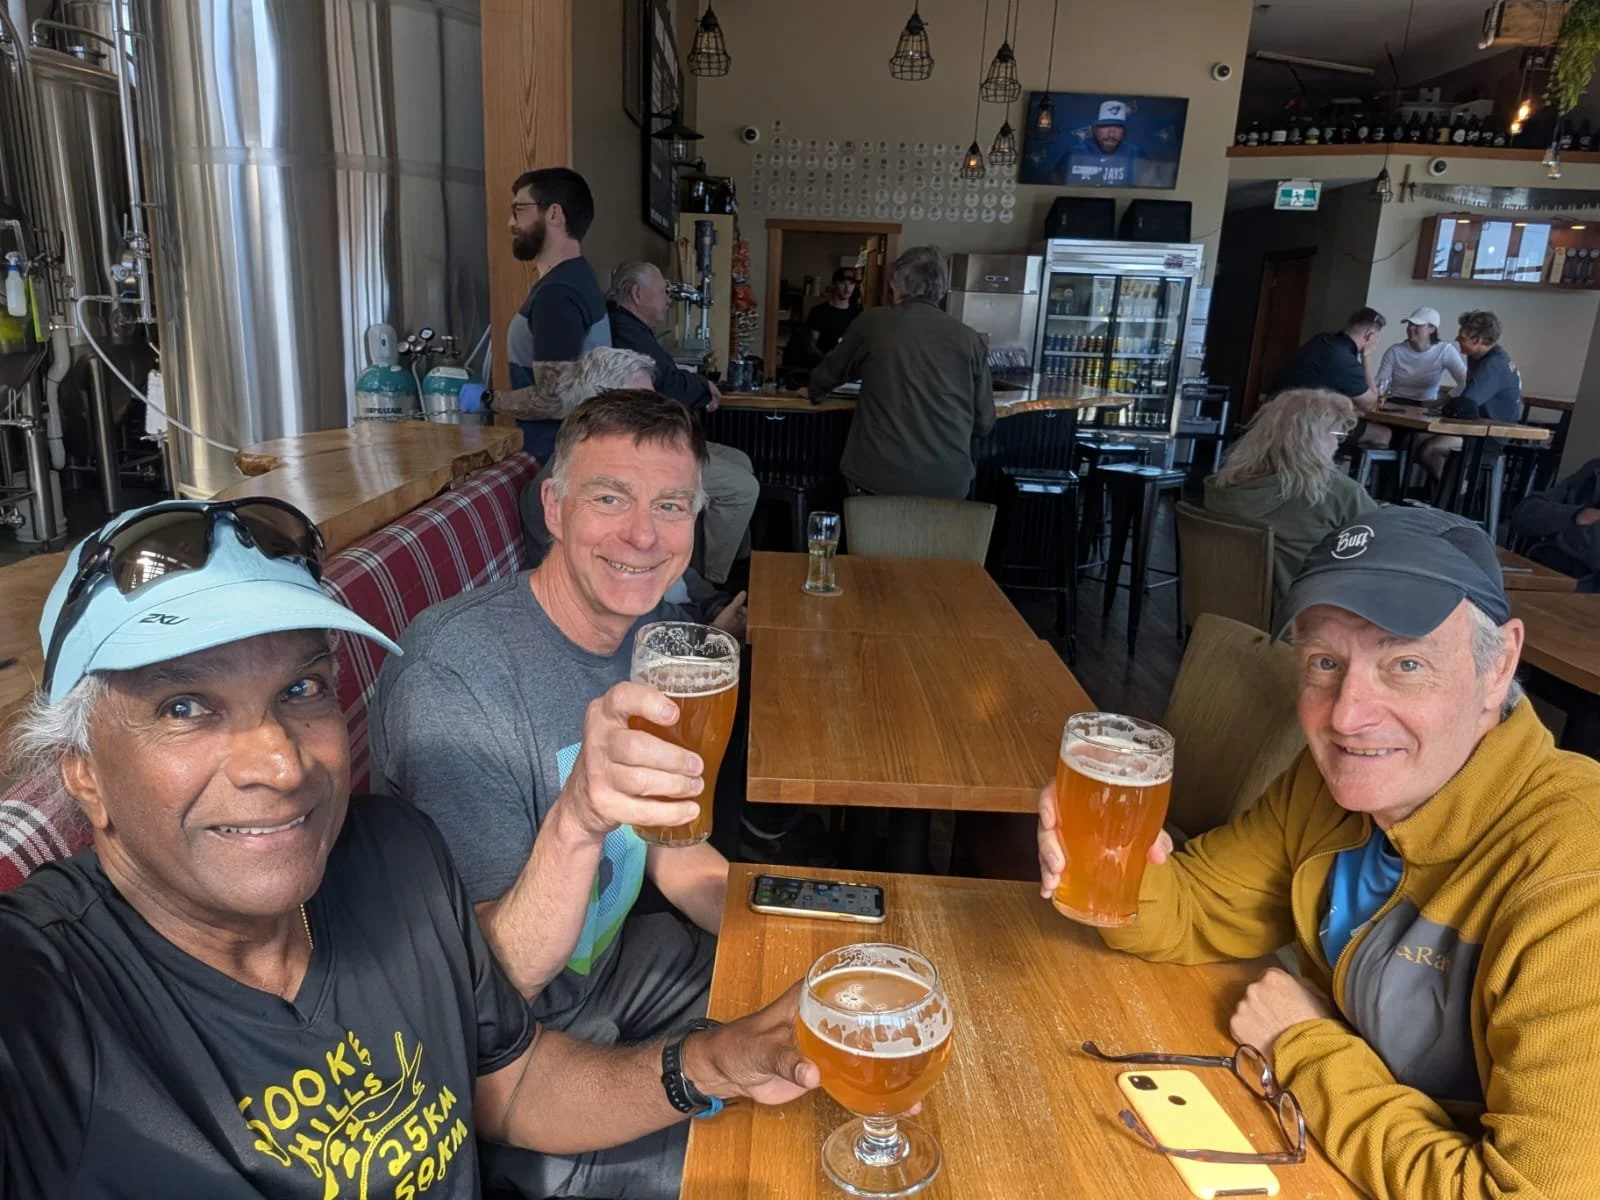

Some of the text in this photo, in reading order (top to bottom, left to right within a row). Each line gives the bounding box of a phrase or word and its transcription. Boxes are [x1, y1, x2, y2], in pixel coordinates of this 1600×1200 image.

[1102, 167, 1125, 181] JAYS
[138, 613, 190, 625] 2XU
[308, 1072, 383, 1179] HILLS
[379, 1085, 457, 1177] 25KM
[395, 1117, 468, 1200] 50KM
